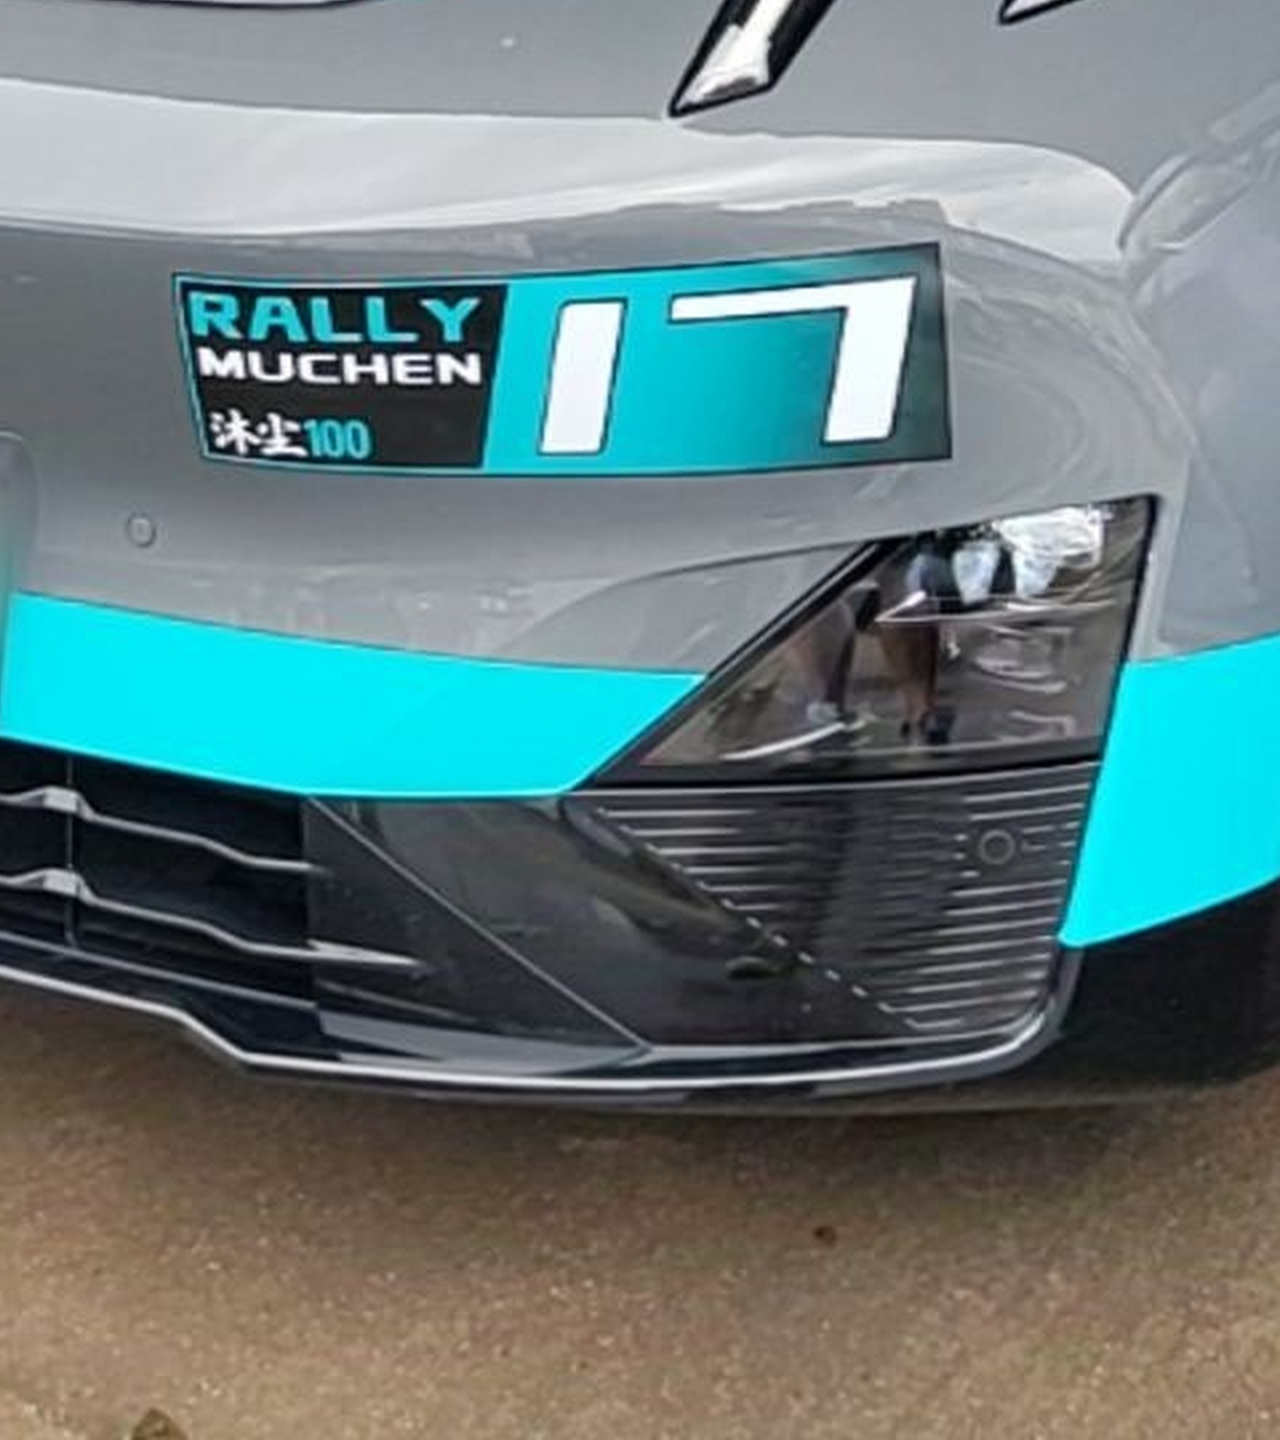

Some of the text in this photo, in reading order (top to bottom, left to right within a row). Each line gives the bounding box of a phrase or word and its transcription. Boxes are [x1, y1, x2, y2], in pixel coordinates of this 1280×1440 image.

[187, 290, 481, 343] RALLY
[196, 346, 482, 385] MUCHEN
[538, 274, 919, 456] 17
